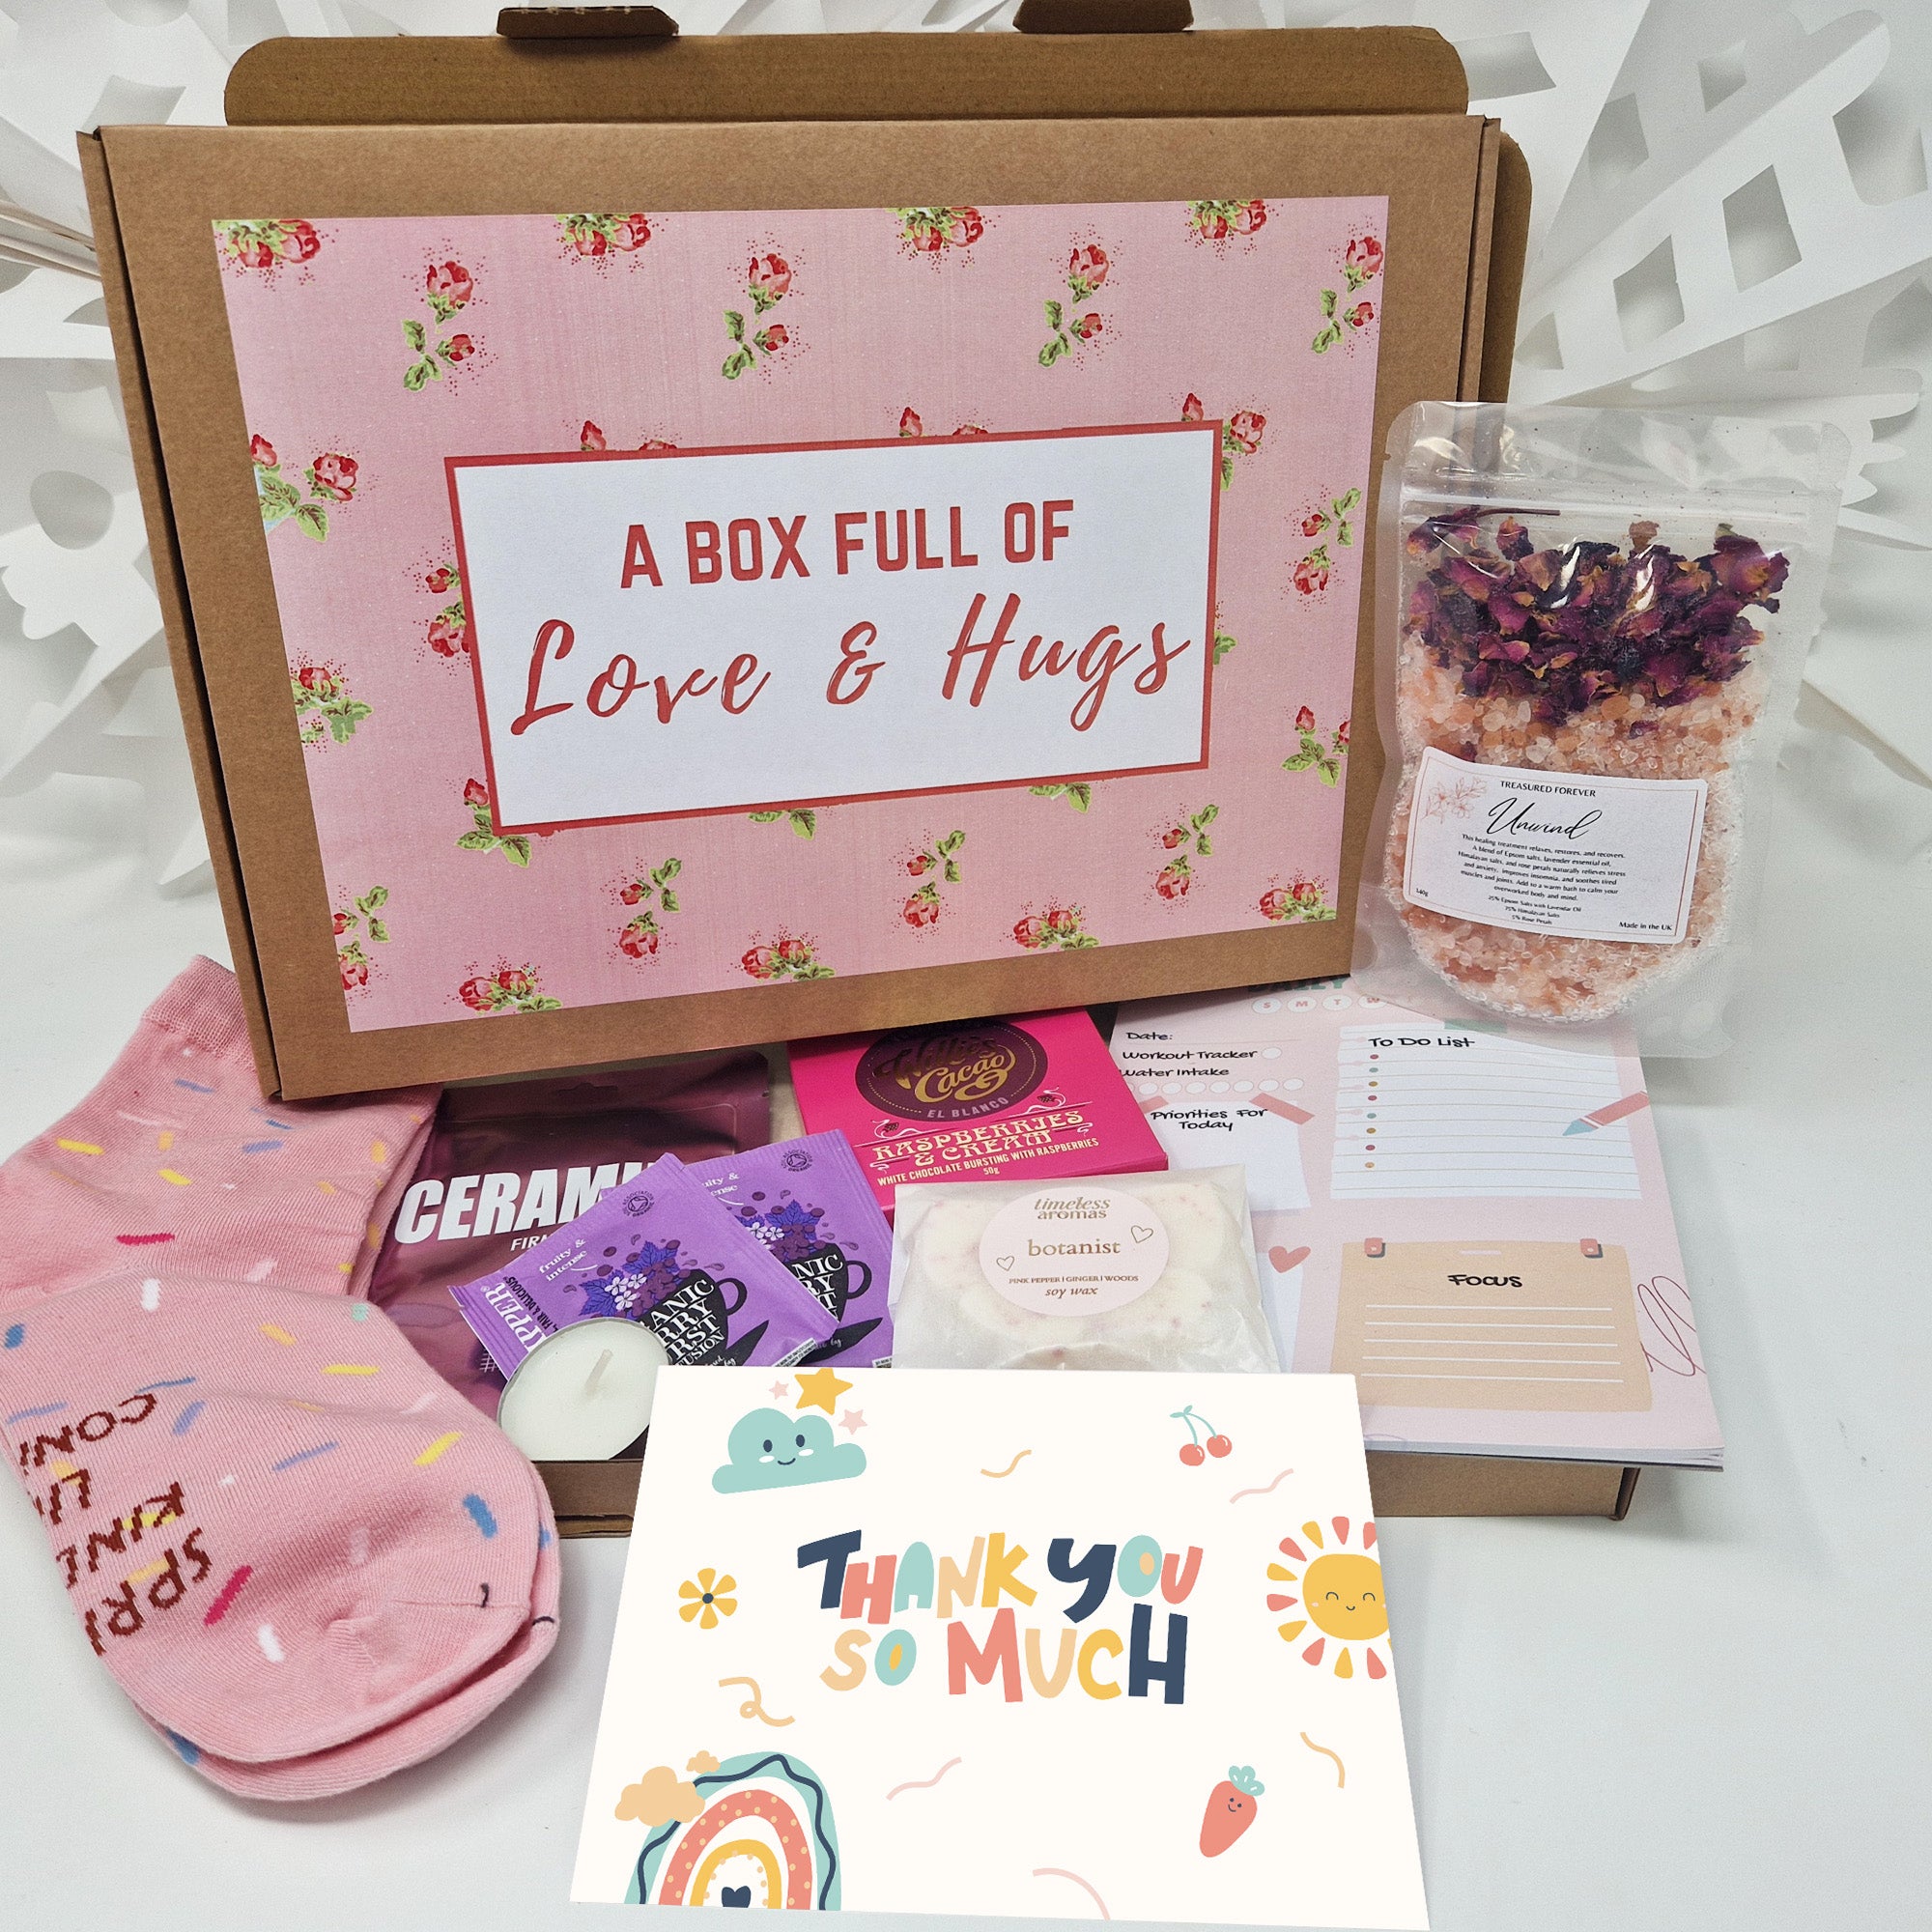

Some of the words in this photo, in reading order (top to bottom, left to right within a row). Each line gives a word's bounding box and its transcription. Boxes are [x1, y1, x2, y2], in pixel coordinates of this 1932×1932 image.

[620, 524, 664, 588] A
[685, 515, 810, 584] BOX
[834, 506, 979, 575] FULL
[1003, 498, 1074, 563] OF
[511, 618, 772, 736] Love
[826, 620, 886, 706] &
[941, 592, 1191, 732] Hugs
[1500, 781, 1552, 793] TREASURED
[1554, 786, 1596, 797] FOREVER
[1486, 797, 1603, 839] Unwind
[1475, 837, 1496, 846] healing
[1497, 841, 1527, 850] treatment
[1493, 885, 1529, 895] overworked
[1125, 1032, 1173, 1040] Date:
[1368, 1037, 1393, 1047] To
[1398, 1037, 1431, 1046] Do
[1438, 1036, 1475, 1047] List
[1122, 1050, 1194, 1060] Workout
[1197, 1050, 1258, 1059] Tracker
[1119, 1068, 1174, 1077] Water
[1177, 1067, 1230, 1076] Intake
[927, 1109, 945, 1119] EL
[952, 1096, 1009, 1118] BLANCO
[1151, 1109, 1228, 1120] Priorities
[1236, 1108, 1268, 1118] For
[872, 1110, 1084, 1161] RASPBERRIES
[1179, 1121, 1234, 1131] Today
[915, 1151, 935, 1167] &
[942, 1130, 1052, 1161] CREAM
[877, 1174, 907, 1186] WHITE
[908, 1163, 963, 1180] CHOCOLATE
[963, 1154, 1009, 1170] BURSTING
[1009, 1150, 1036, 1161] WITH
[1037, 1138, 1099, 1156] RASPBERRIES
[983, 1167, 1000, 1176] 50g
[394, 1162, 662, 1244] CERAM
[1034, 1197, 1111, 1210] timeless
[1037, 1209, 1107, 1220] aromas
[539, 1248, 571, 1273] fruity
[575, 1239, 586, 1248] &
[1027, 1238, 1121, 1257] botanist
[546, 1250, 587, 1281] intense
[1044, 1288, 1066, 1299] soy
[1070, 1287, 1098, 1295] wax
[640, 1279, 715, 1332] ANIC
[536, 1312, 554, 1329] FAIR
[667, 1314, 721, 1361] RST
[797, 1528, 1038, 1625] THANK
[1047, 1534, 1204, 1624] YOU
[819, 1629, 918, 1692] SO
[947, 1603, 1188, 1705] MUCH
